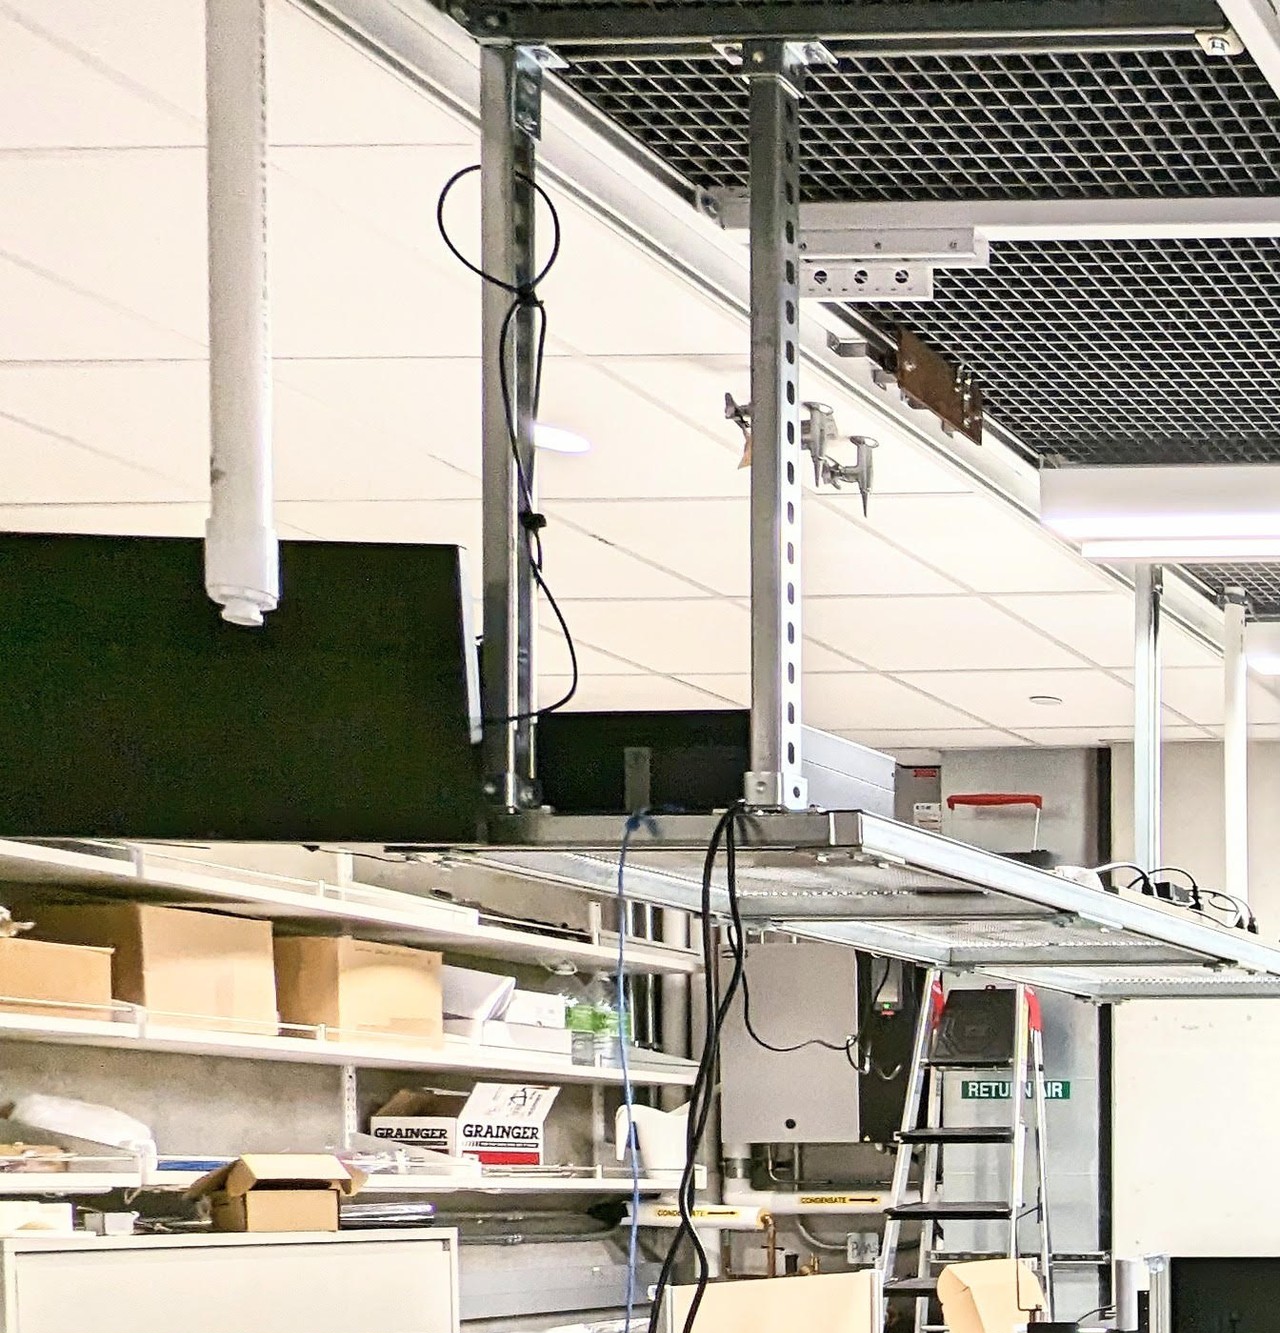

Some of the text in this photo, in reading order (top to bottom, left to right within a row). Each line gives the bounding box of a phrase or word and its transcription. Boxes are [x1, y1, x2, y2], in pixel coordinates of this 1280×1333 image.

[374, 1127, 448, 1139] GRAINGER
[462, 1123, 539, 1140] GRAINGER
[801, 1196, 847, 1204] CONDENSATE
